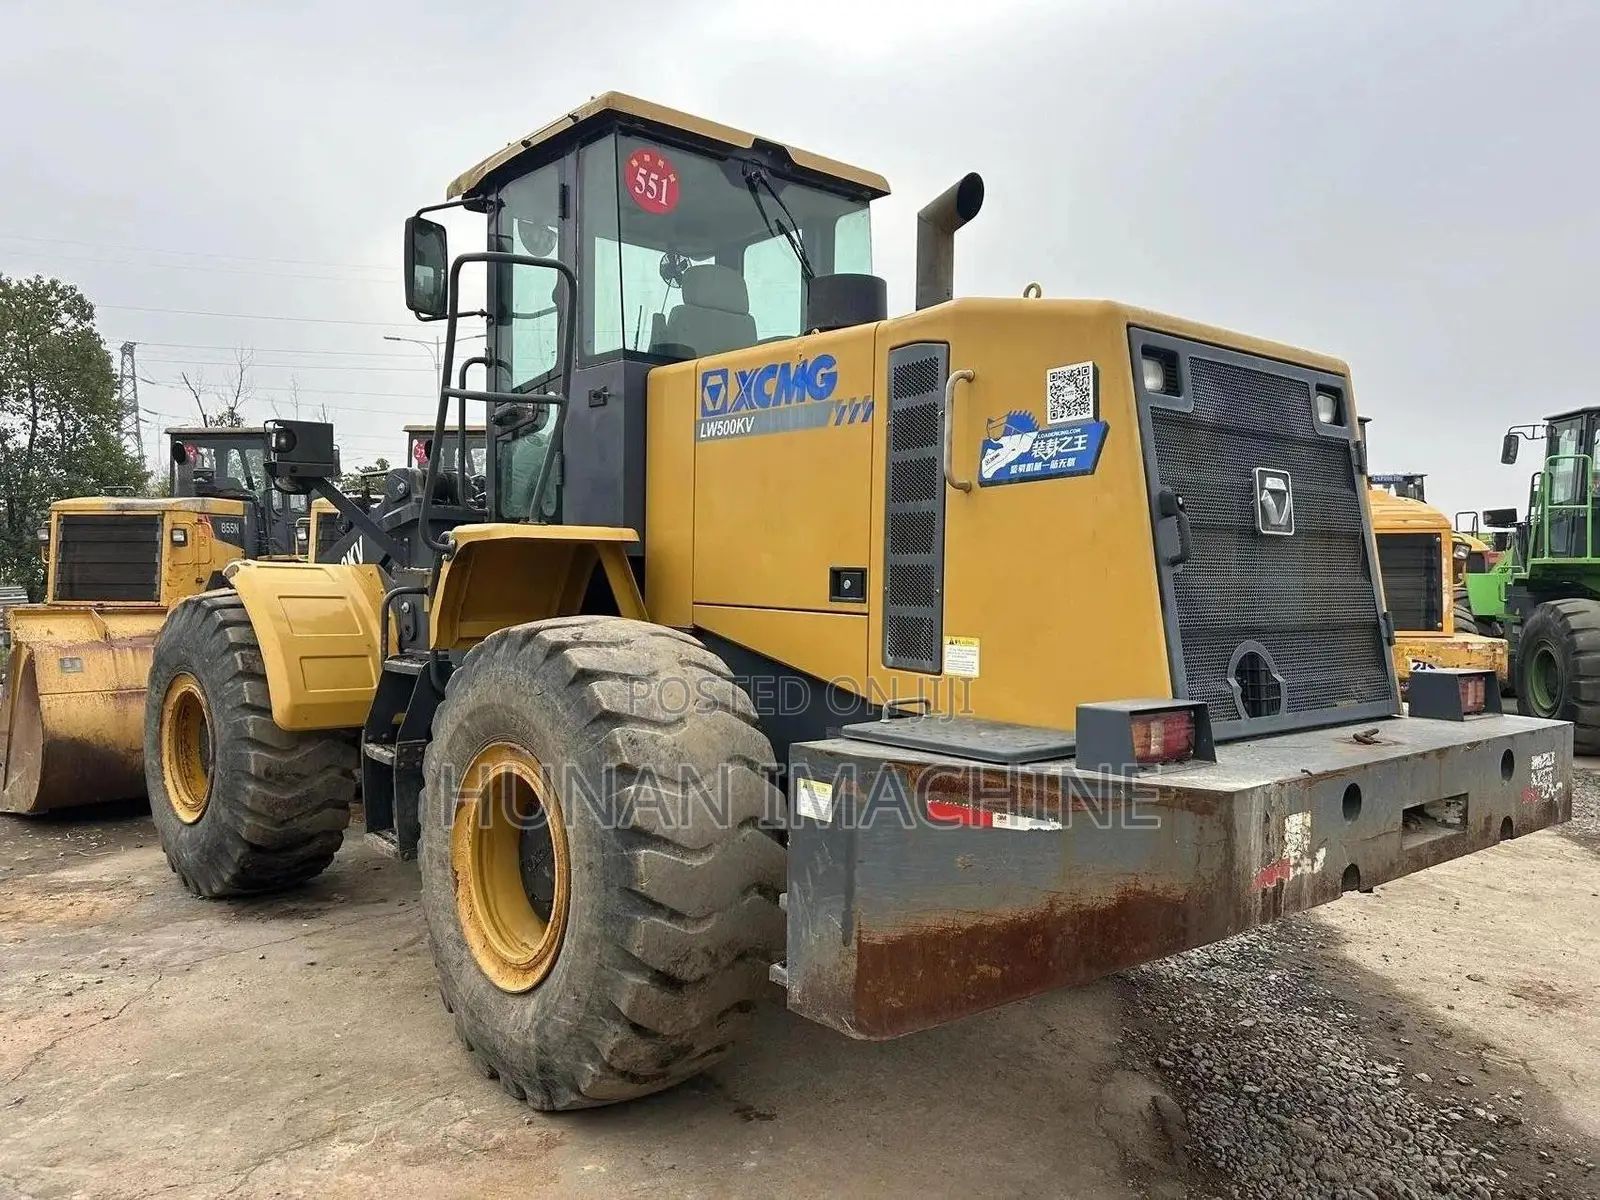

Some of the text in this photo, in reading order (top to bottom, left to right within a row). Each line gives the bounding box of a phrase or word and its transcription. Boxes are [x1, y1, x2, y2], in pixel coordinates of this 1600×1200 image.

[634, 167, 668, 206] 551
[727, 354, 838, 413] XCMG
[700, 416, 755, 438] LW500KV
[220, 522, 240, 534] 855N
